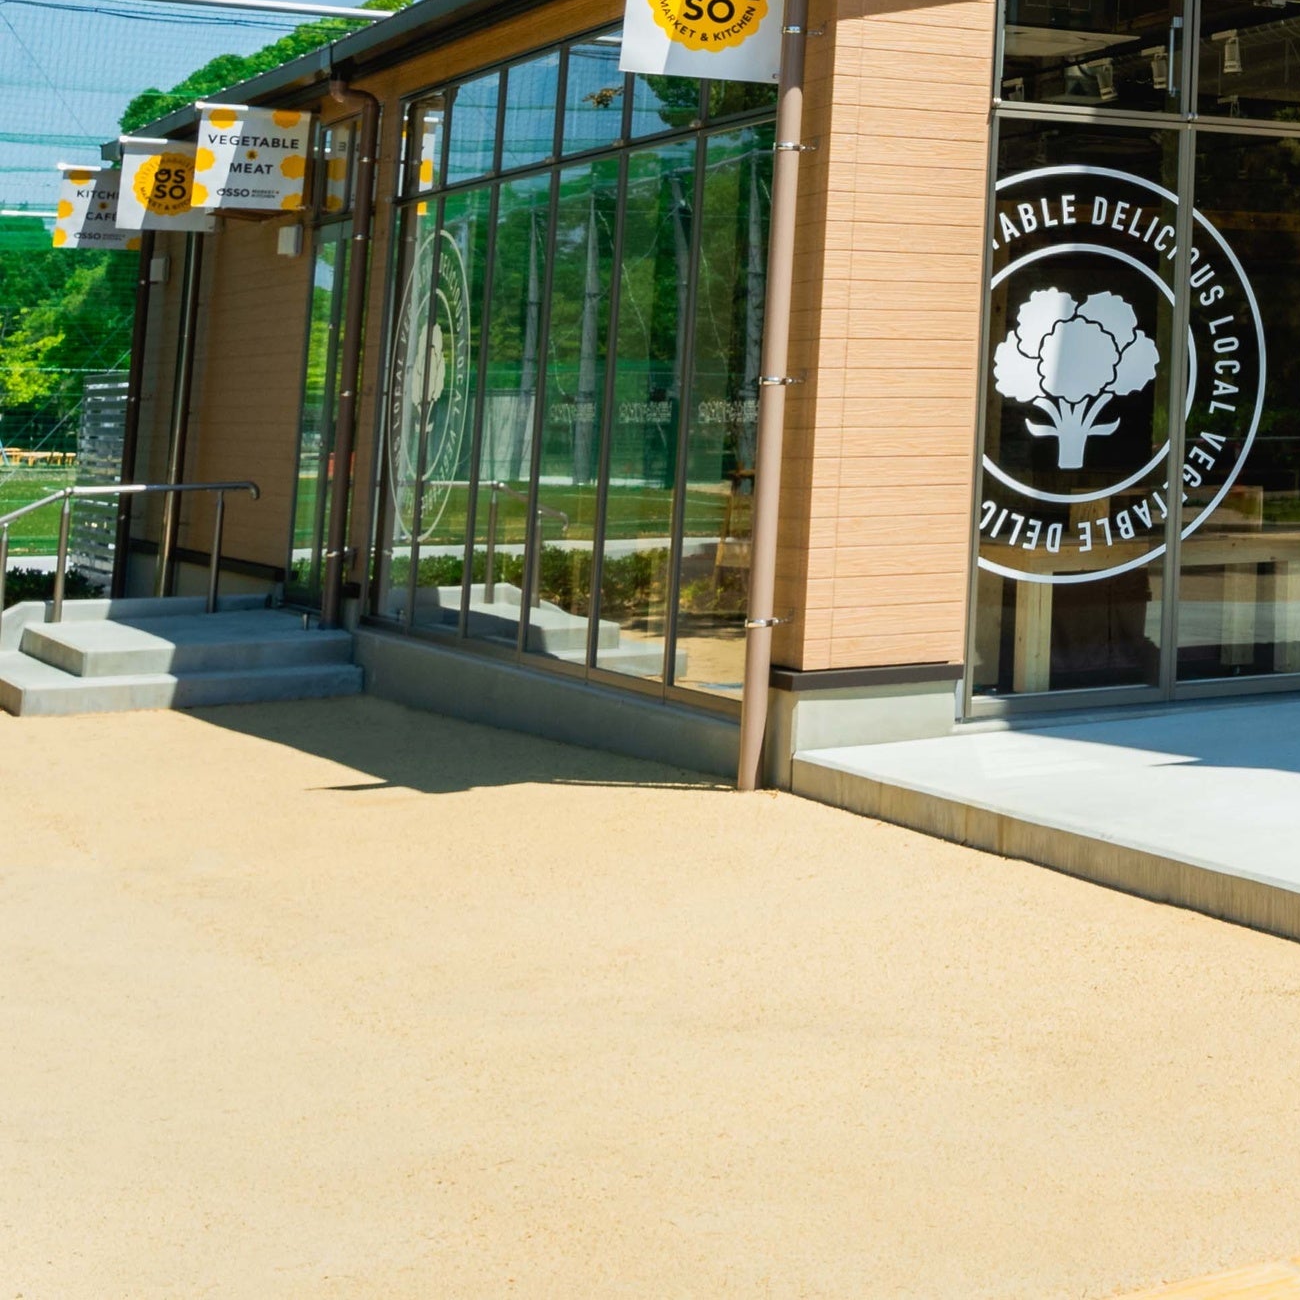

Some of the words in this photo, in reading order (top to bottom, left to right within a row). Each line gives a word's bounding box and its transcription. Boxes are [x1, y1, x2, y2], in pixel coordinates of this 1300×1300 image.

[700, 33, 708, 42] &
[713, 6, 756, 41] KITCHEN
[208, 134, 299, 149] VEGETABLE
[230, 163, 274, 175] MEAT
[76, 190, 119, 199] KITCH
[992, 195, 1076, 250] ABLE
[1208, 314, 1240, 415] LOCAL
